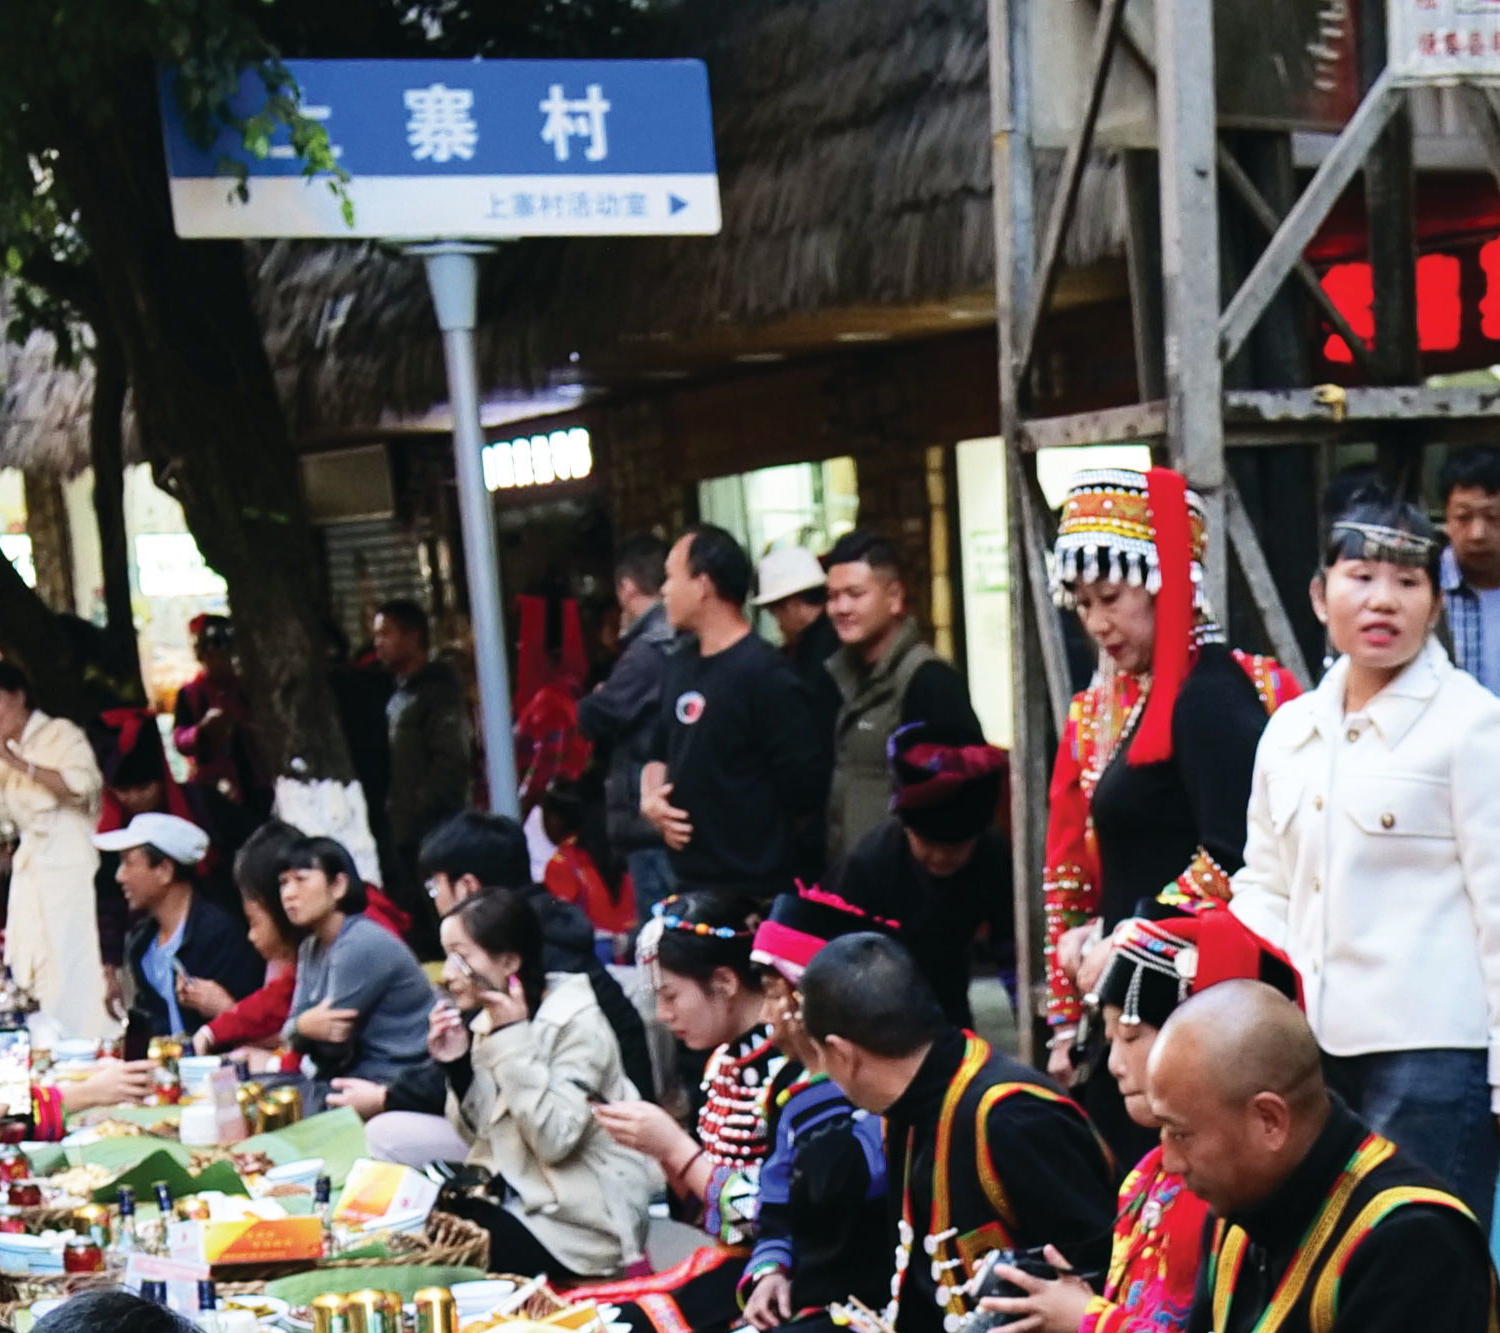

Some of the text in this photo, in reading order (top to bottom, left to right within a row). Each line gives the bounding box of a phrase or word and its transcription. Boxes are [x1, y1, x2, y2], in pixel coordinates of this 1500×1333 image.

[485, 193, 648, 220] 上寨村活动室
